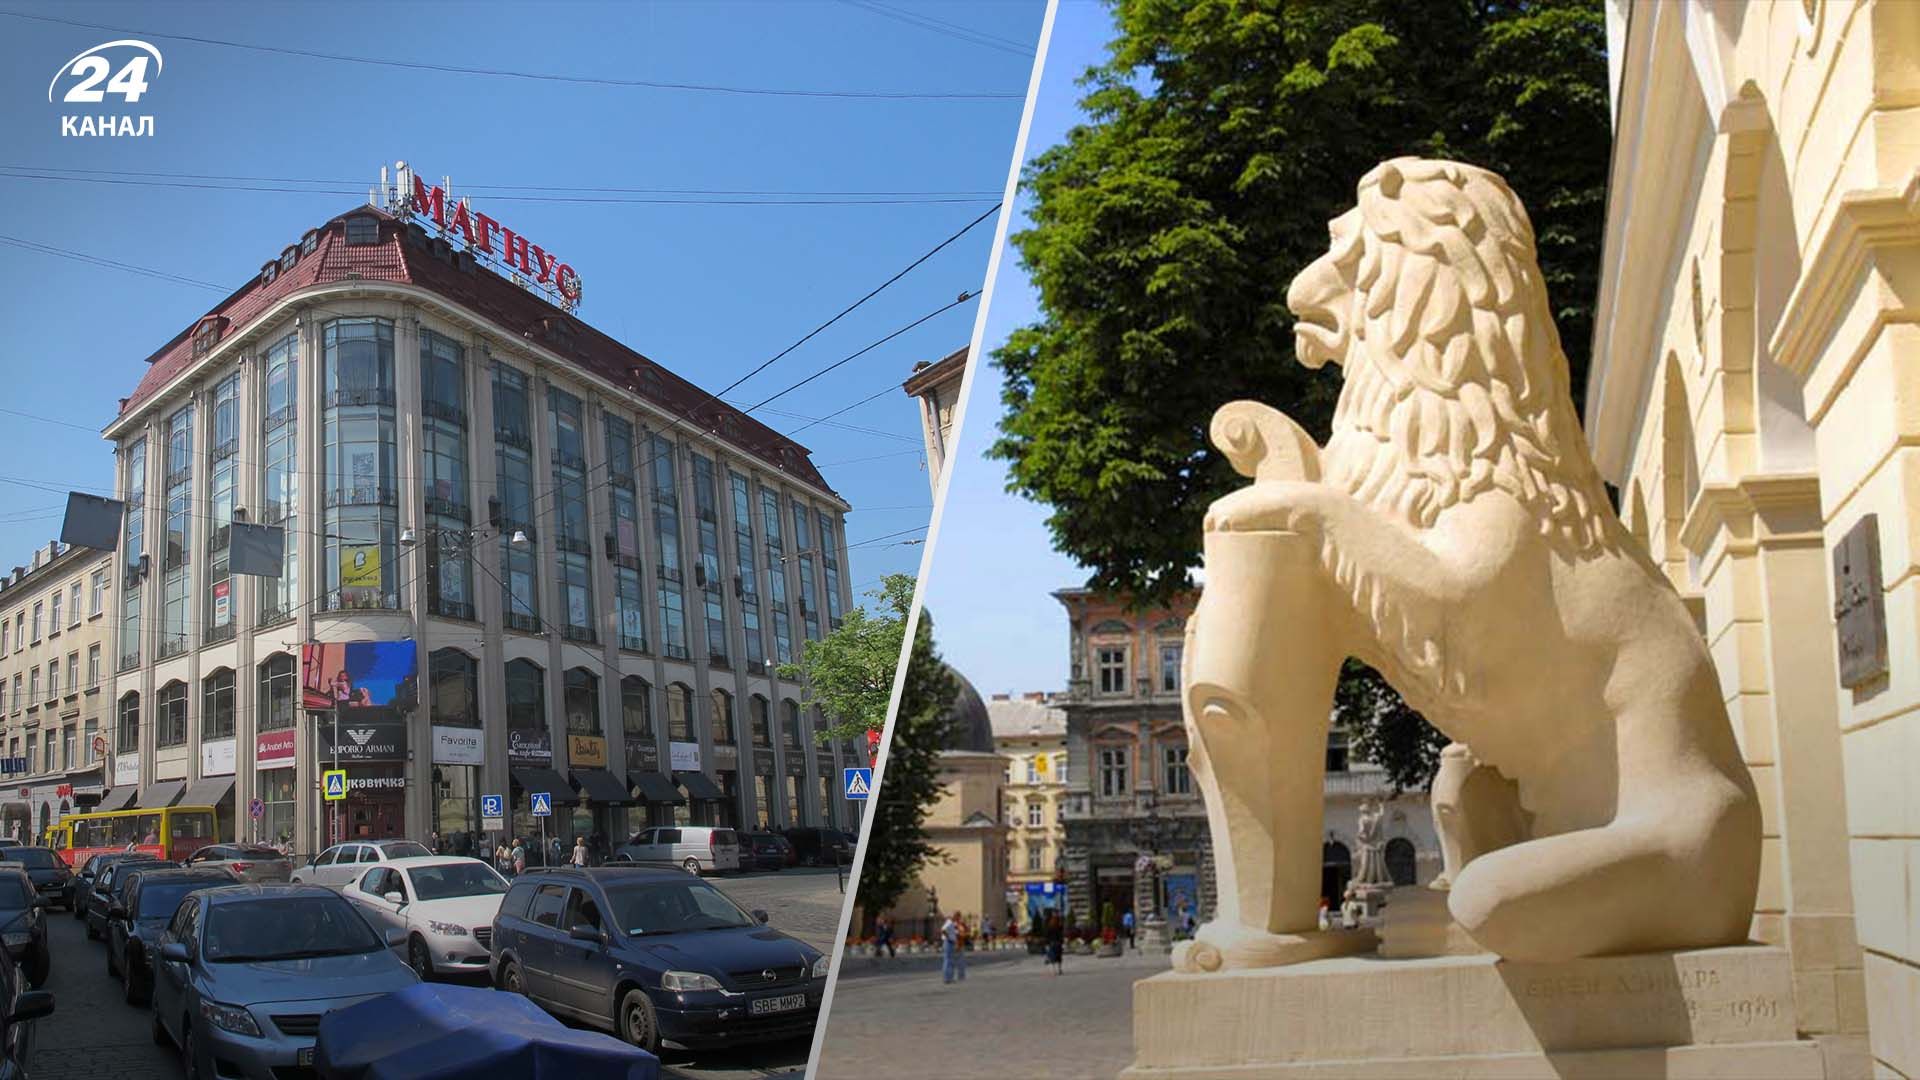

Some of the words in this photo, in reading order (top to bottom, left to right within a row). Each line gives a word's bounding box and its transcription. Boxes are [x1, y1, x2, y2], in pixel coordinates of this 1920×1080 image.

[411, 174, 578, 300] МАГНУС
[365, 744, 395, 753] ARMANI
[346, 777, 405, 792] укавичка
